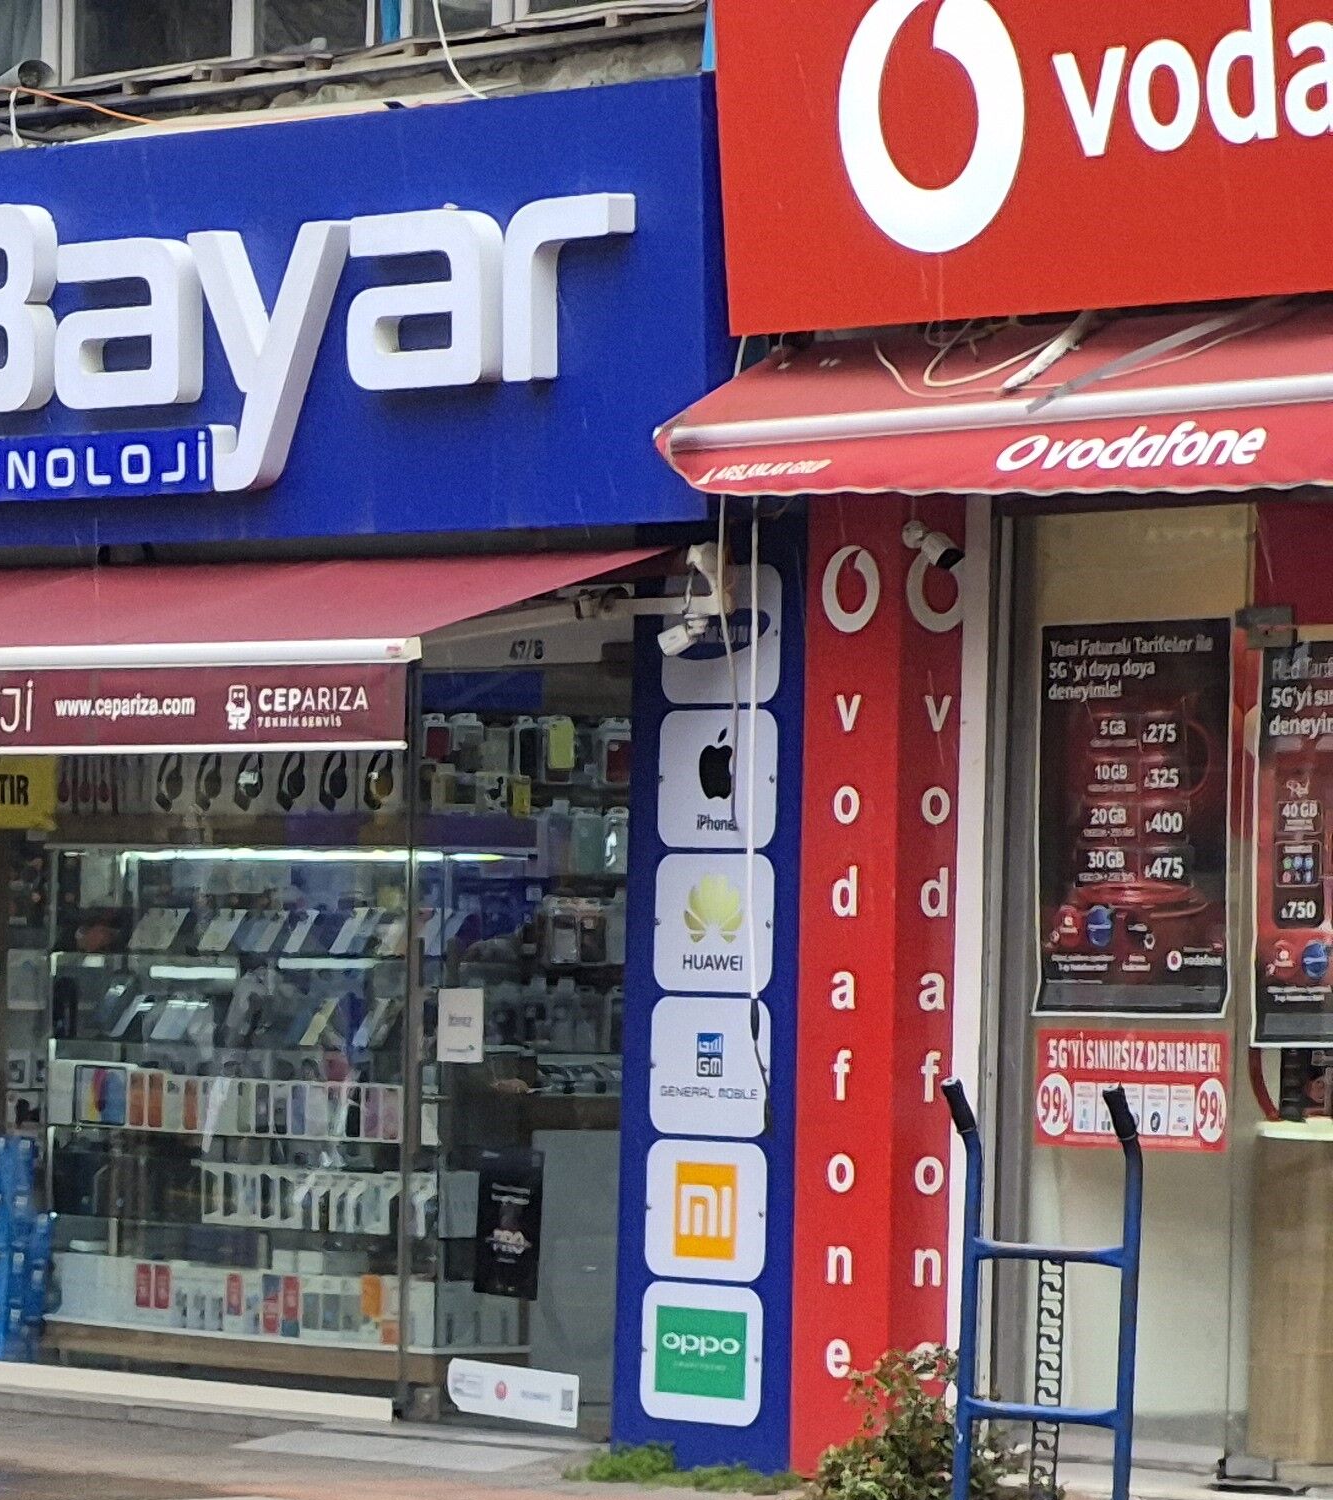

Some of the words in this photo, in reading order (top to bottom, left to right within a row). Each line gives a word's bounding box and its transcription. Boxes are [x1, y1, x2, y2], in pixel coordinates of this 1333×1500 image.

[1040, 419, 1268, 470] vodafone
[1049, 639, 1079, 658] Yeni
[1081, 637, 1132, 657] Faturalı
[1134, 634, 1194, 654] Tarifeler
[1196, 633, 1214, 652] ile
[1089, 660, 1120, 680] doya
[1122, 659, 1156, 678] doya
[53, 692, 196, 721] www.cepariza.com
[1100, 720, 1108, 736] 5
[1109, 719, 1127, 735] GB
[1095, 764, 1110, 780] 10
[1111, 764, 1128, 780] GB
[1090, 808, 1106, 825] 20
[1109, 808, 1127, 824] GB
[1282, 803, 1298, 818] 40
[1300, 803, 1318, 818] GB
[1087, 851, 1104, 869] 30
[1106, 851, 1126, 869] GB
[682, 954, 743, 972] HUAWEI
[660, 1085, 715, 1099] GENERAL
